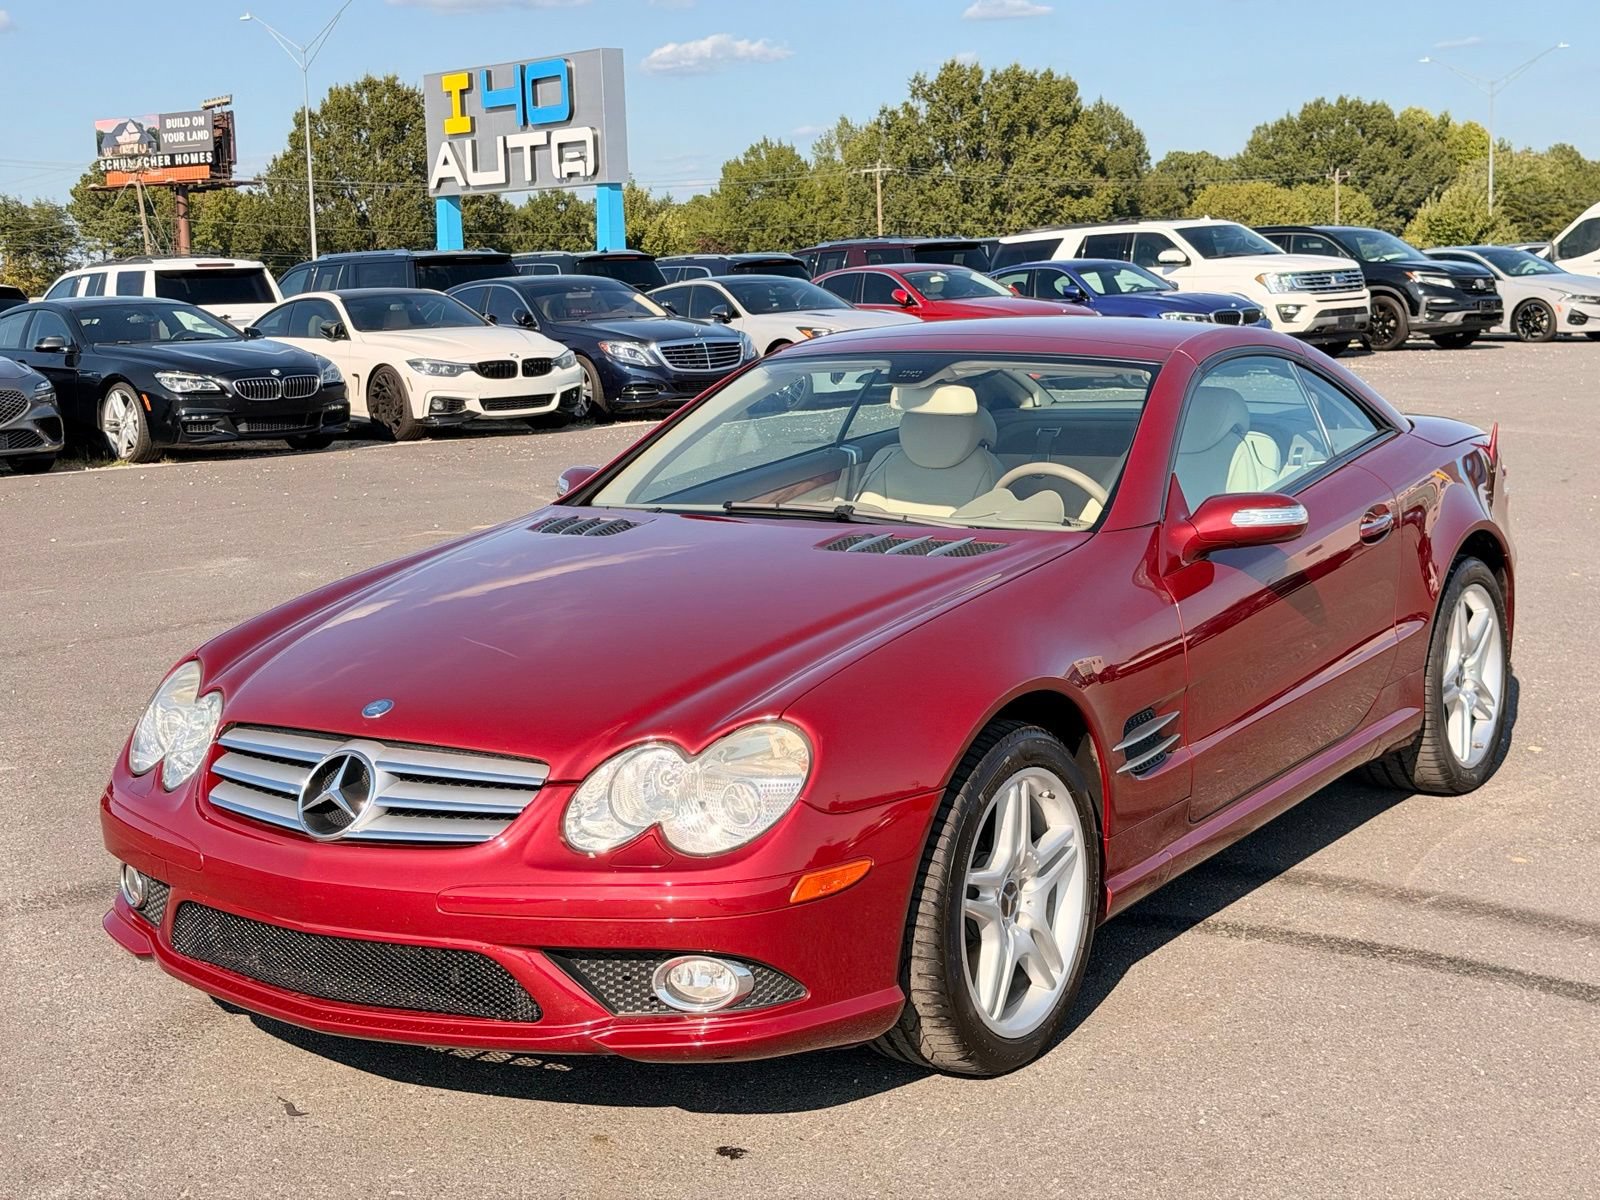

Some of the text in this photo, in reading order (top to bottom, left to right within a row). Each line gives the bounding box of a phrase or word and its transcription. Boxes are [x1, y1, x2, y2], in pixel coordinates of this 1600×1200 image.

[166, 116, 205, 129] BUILD ON
[162, 130, 209, 143] YOUR LAND
[175, 152, 213, 165] HOMES
[429, 127, 594, 189] AUTO
